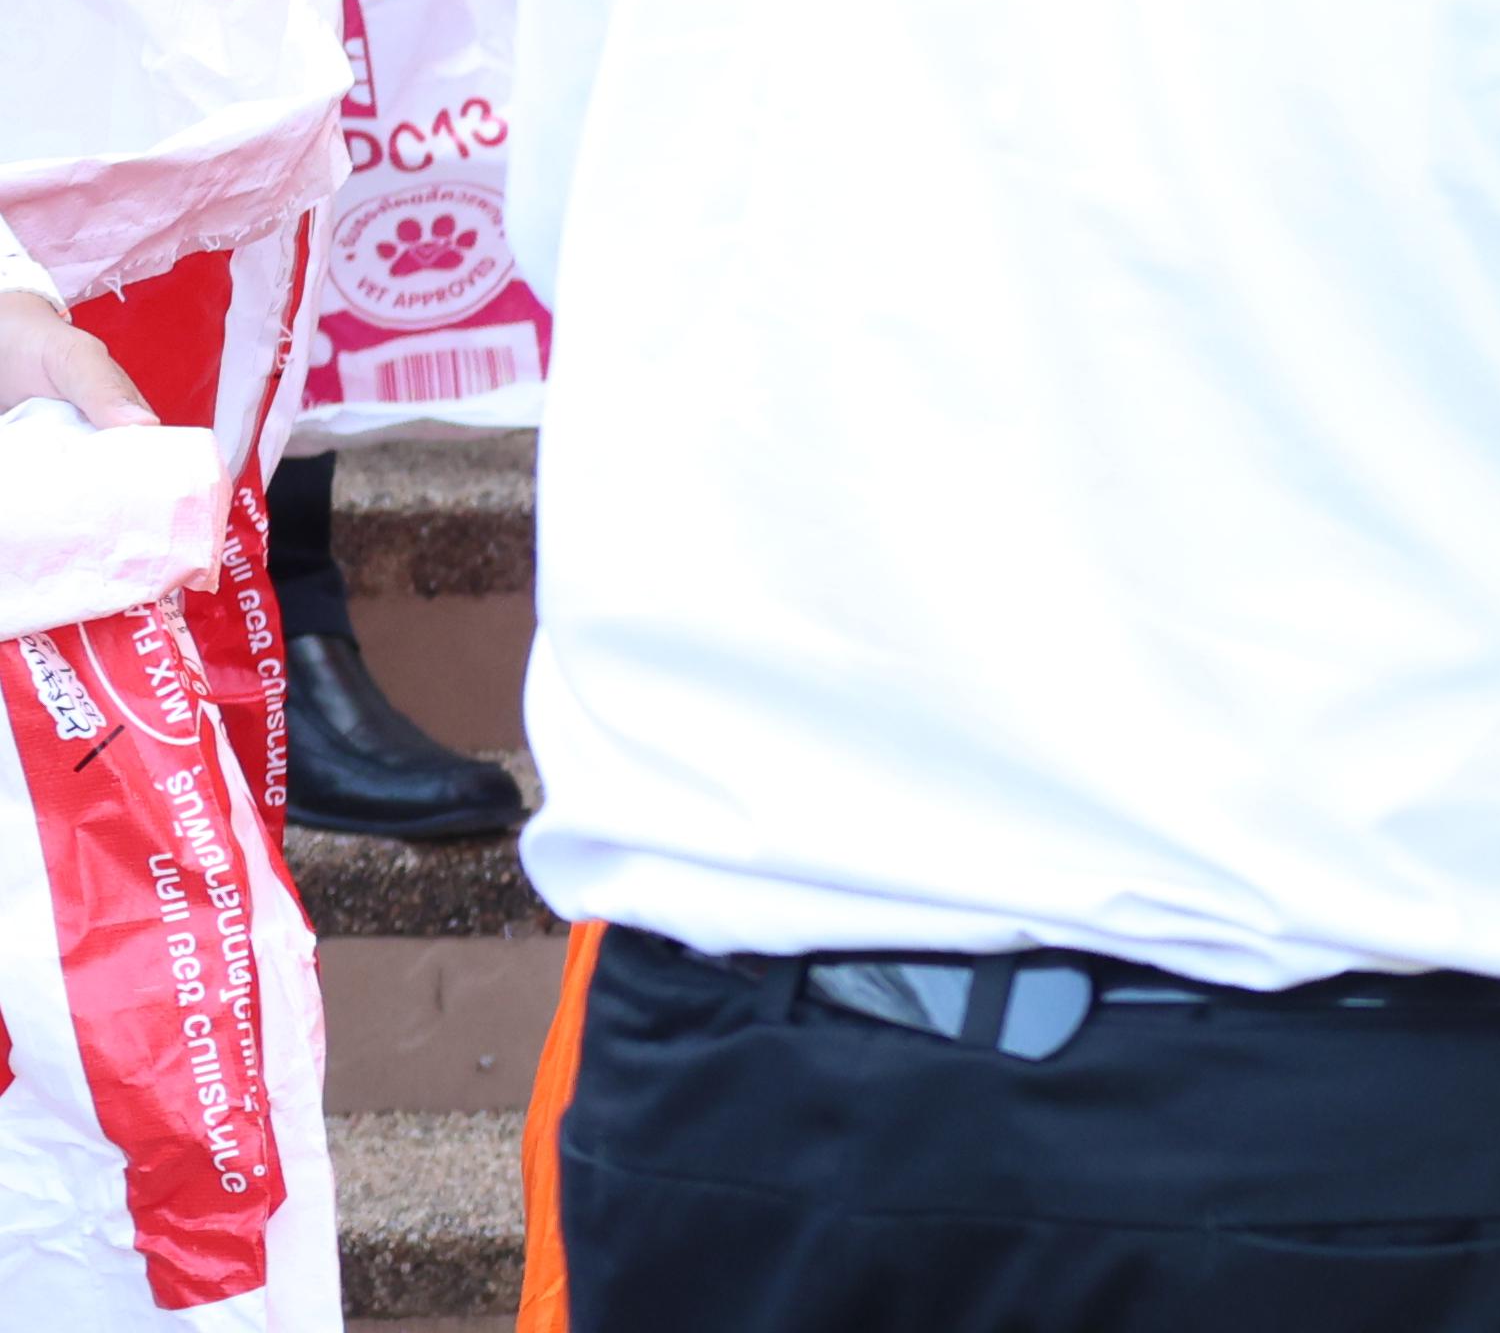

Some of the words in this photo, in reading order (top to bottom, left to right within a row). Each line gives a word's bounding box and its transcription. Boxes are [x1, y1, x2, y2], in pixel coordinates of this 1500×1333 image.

[146, 657, 193, 725] MIX
[148, 851, 191, 924] แคท
[166, 932, 206, 1008] ซอย
[183, 1013, 248, 1194] อาหารแมว
